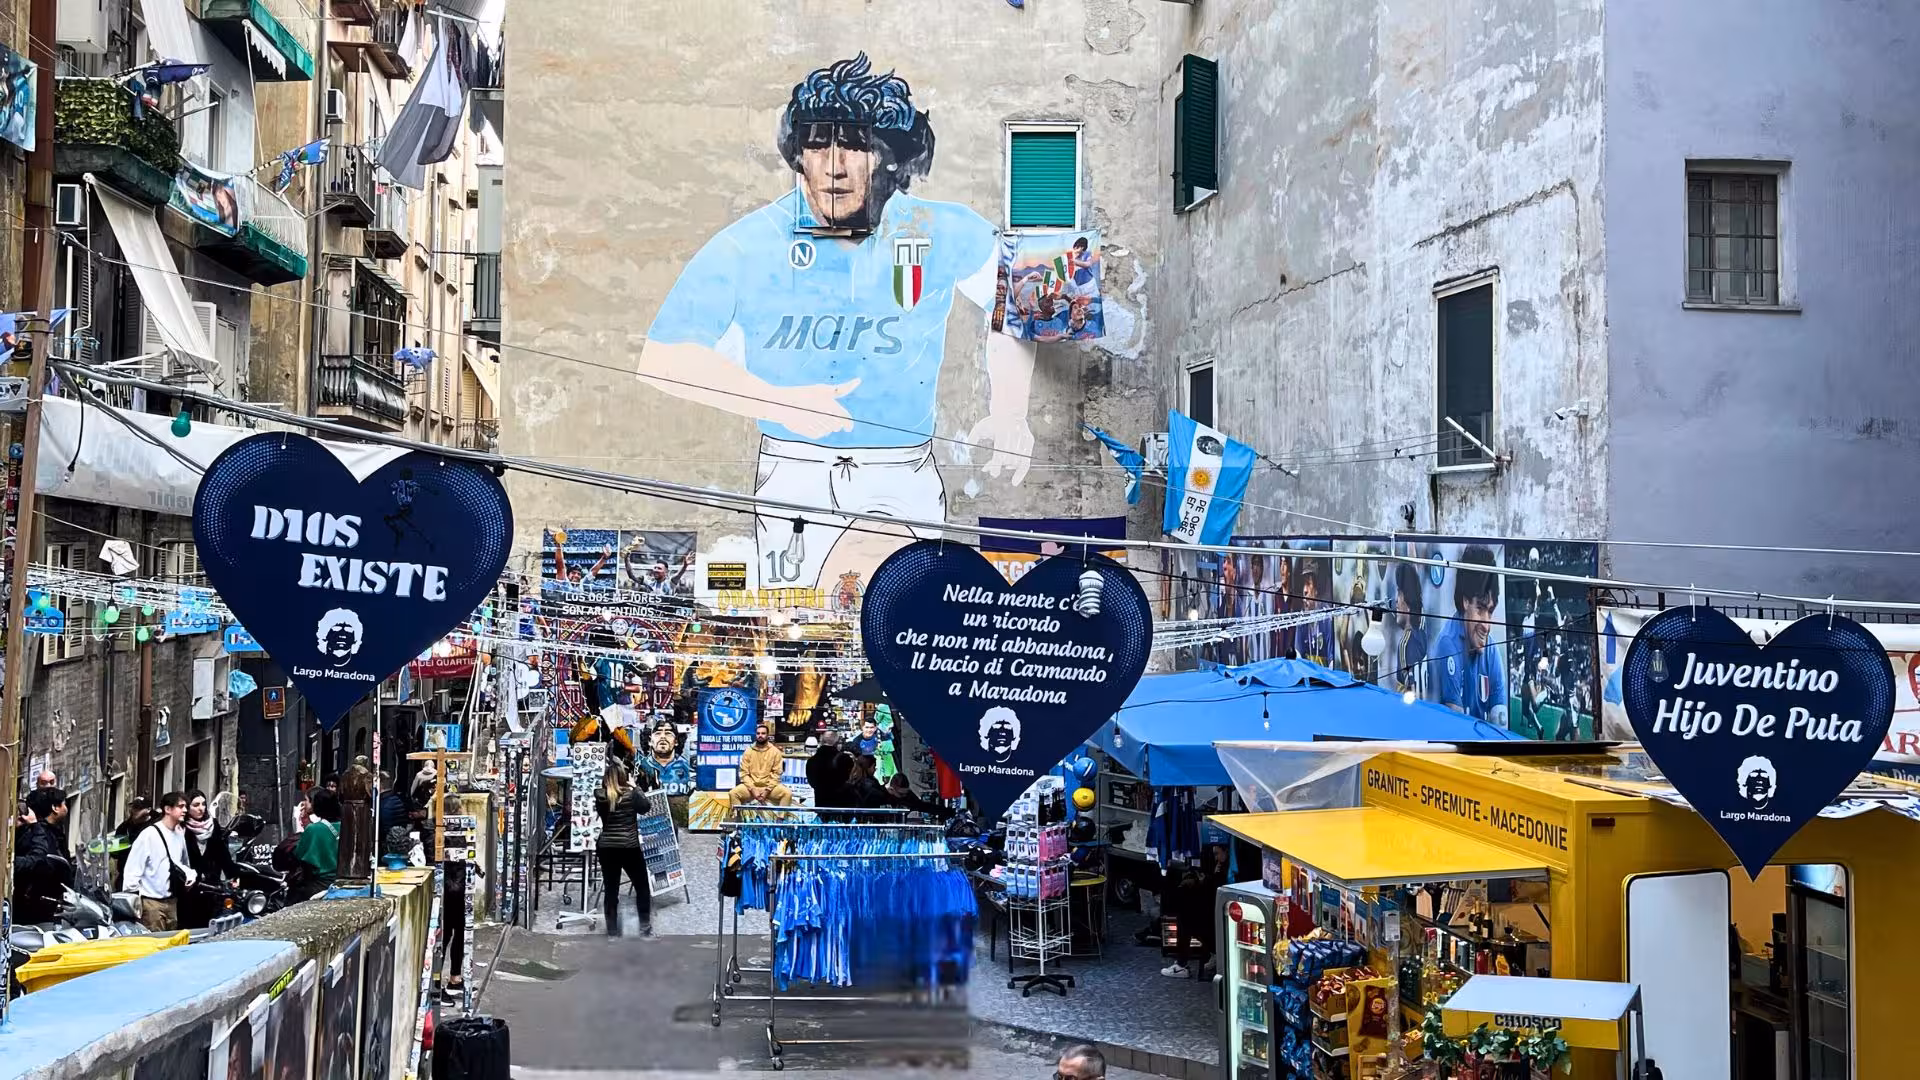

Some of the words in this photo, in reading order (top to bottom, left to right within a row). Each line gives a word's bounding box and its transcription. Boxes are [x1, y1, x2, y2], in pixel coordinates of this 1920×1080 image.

[298, 553, 450, 602] EXISTE
[943, 584, 994, 605] Nella
[998, 590, 1055, 610] mente
[963, 612, 988, 628] un
[993, 613, 1061, 634] ricordo
[895, 629, 928, 647] che
[931, 633, 968, 650] non
[972, 634, 997, 651] mi
[293, 666, 323, 679] Largo
[325, 668, 376, 682] Maradona
[929, 653, 980, 675] bacio
[983, 657, 1003, 676] di
[1010, 658, 1107, 683] Carmando
[1674, 652, 1839, 693] Juventino
[948, 683, 962, 696] a
[968, 680, 1067, 705] Maradona
[1652, 697, 1722, 740] Hijo
[1732, 704, 1776, 739] De
[1785, 706, 1863, 743] Puta
[959, 763, 986, 774] Largo
[987, 765, 1034, 776] Maradona
[1368, 768, 1410, 799] GRANITE
[1420, 785, 1480, 822] SPREMUTE
[1490, 805, 1568, 850] MACEDONIE
[1720, 810, 1746, 821] Largo
[1747, 812, 1791, 823] Maradona
